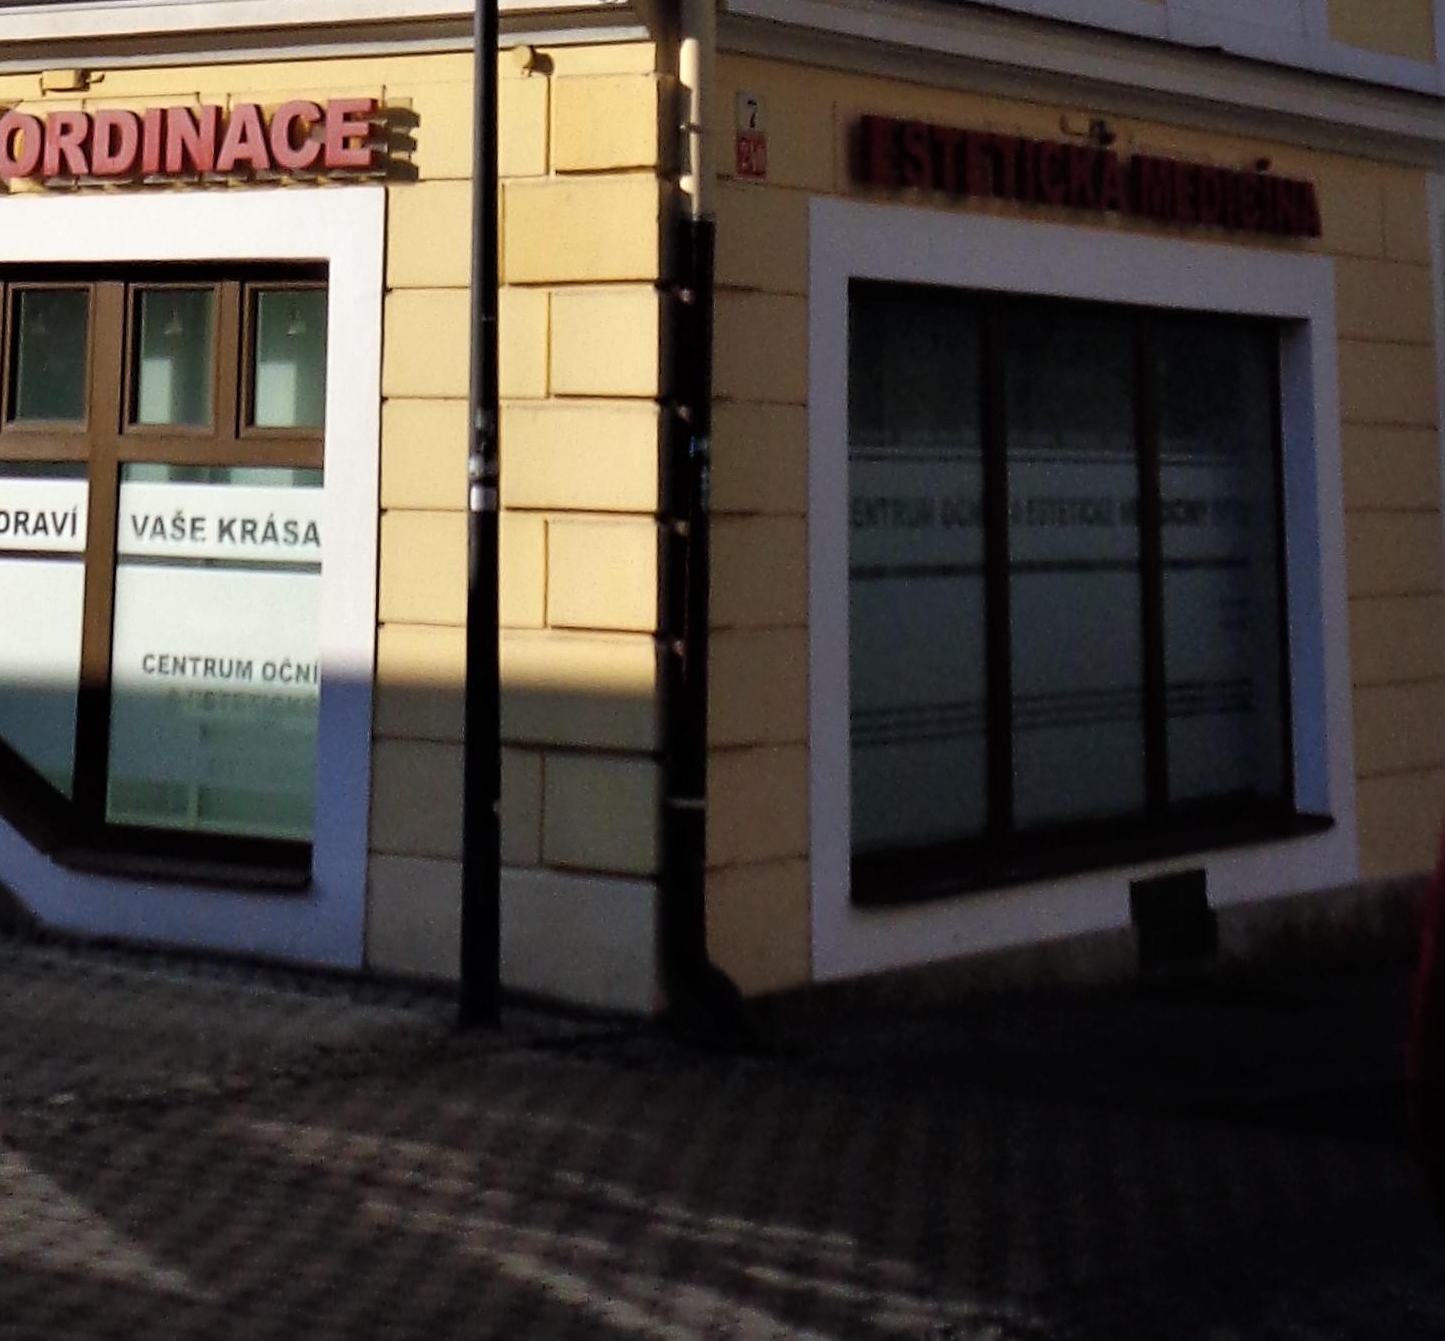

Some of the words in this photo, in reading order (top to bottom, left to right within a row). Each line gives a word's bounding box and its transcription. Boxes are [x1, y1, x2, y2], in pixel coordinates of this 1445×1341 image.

[131, 510, 206, 543] VAŠE
[217, 512, 321, 548] KRÁSA
[142, 653, 253, 683] CENTRUM
